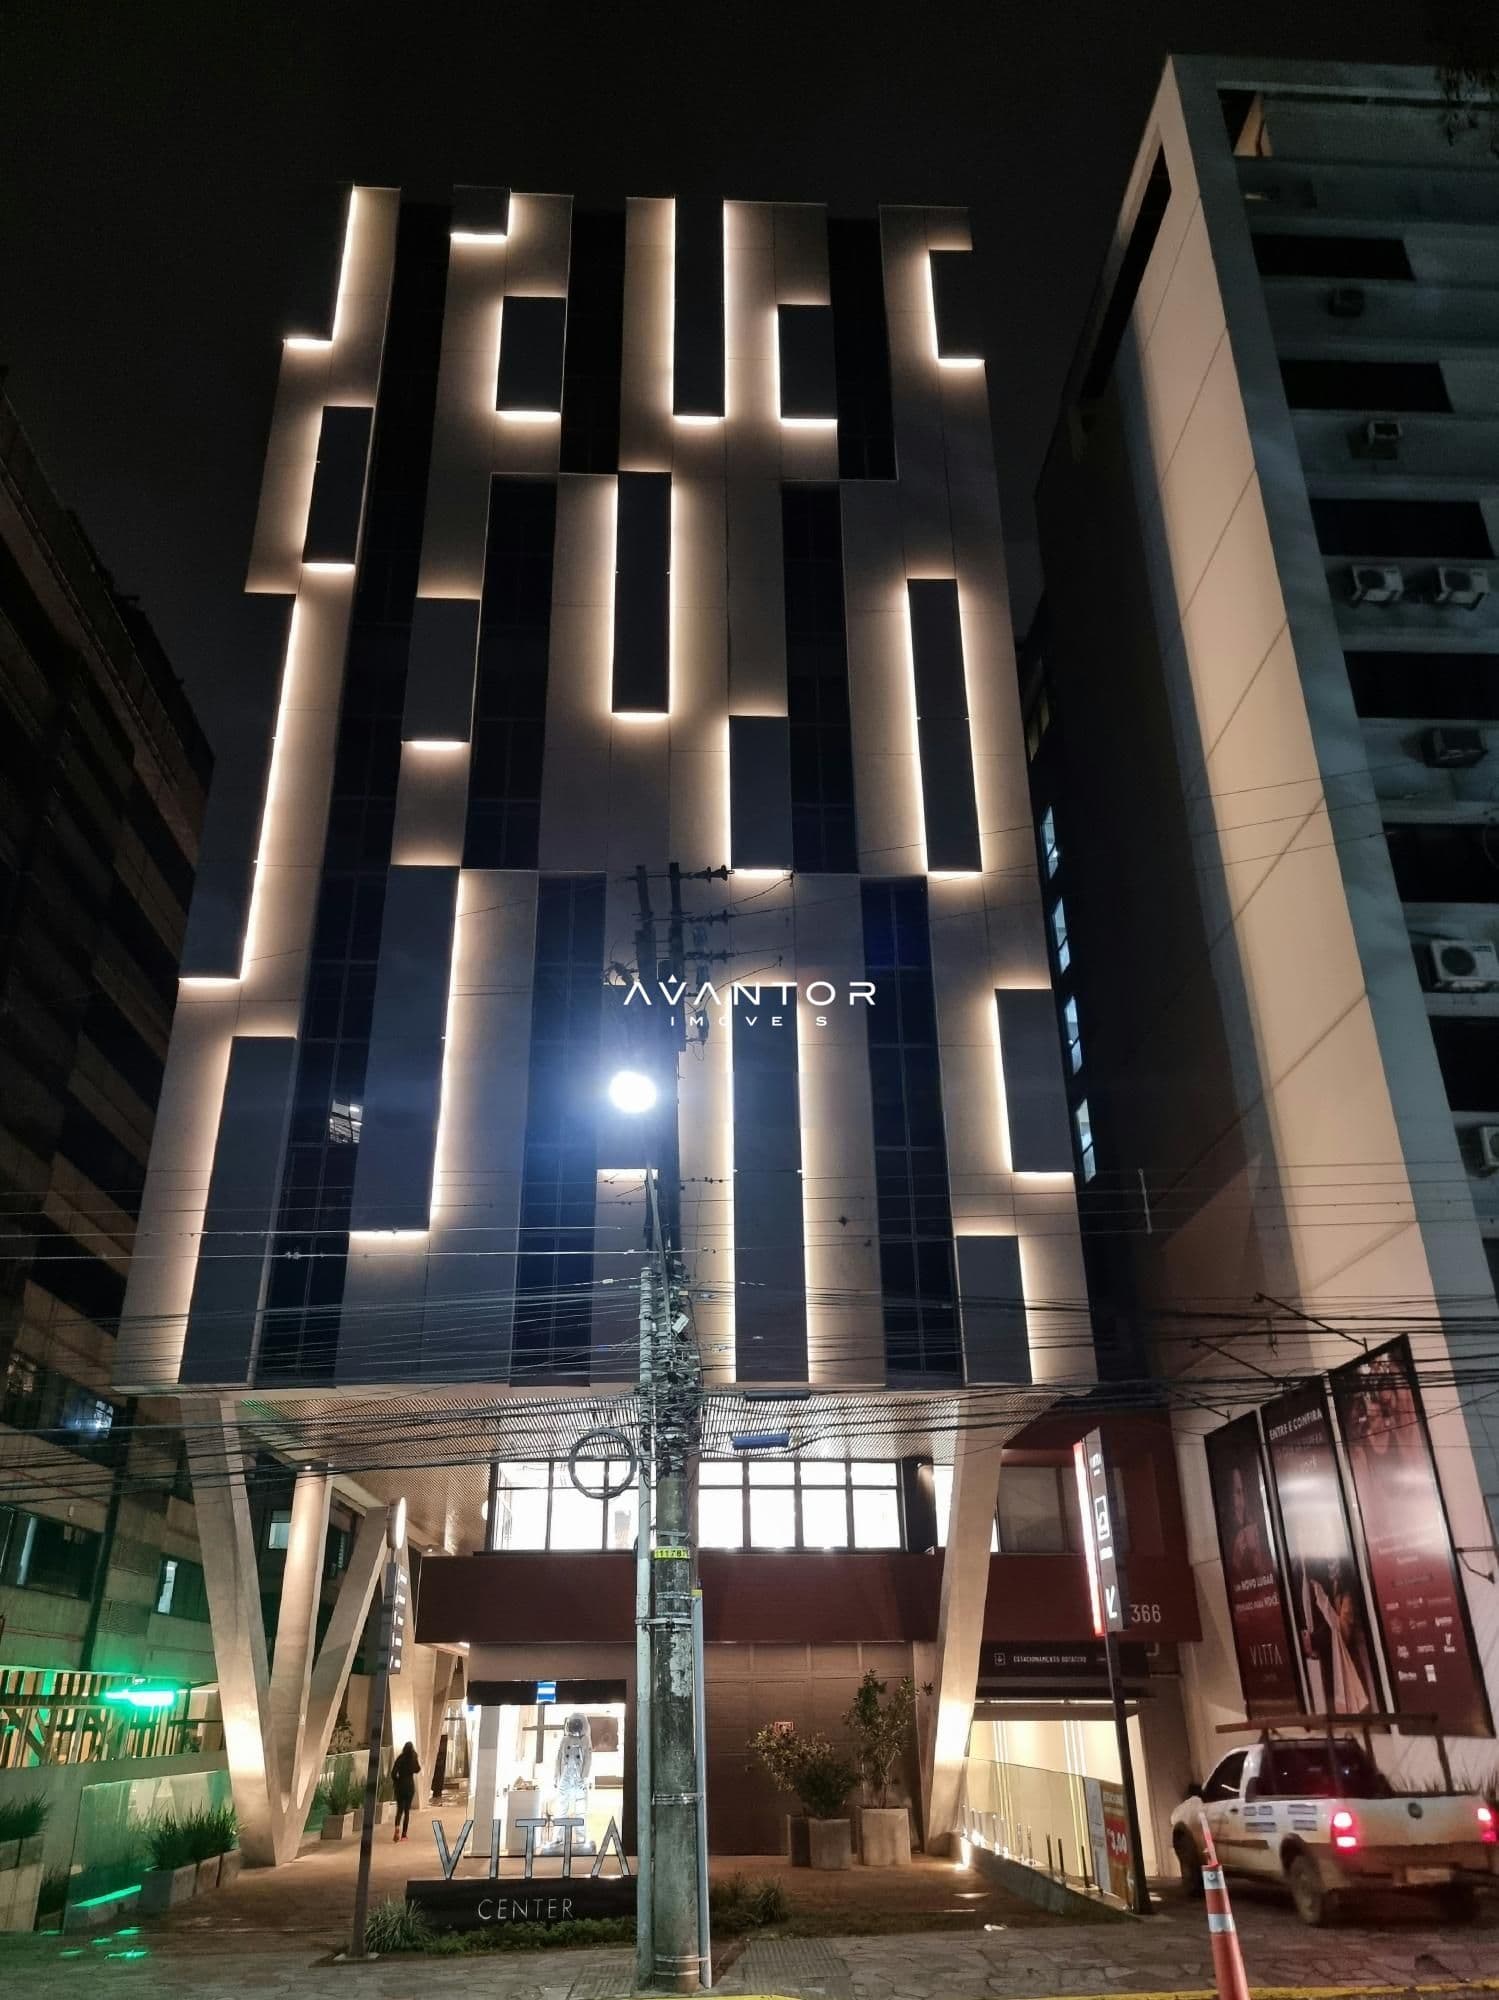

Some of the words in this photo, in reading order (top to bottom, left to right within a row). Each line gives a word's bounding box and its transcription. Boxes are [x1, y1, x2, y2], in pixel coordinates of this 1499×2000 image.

[1268, 1423, 1288, 1441] ENTRE
[1293, 1407, 1324, 1431] CONFIRA
[1129, 1603, 1162, 1624] 366
[1249, 1643, 1284, 1667] VITTA
[431, 1815, 632, 1880] VITTA
[477, 1897, 575, 1921] CENTER
